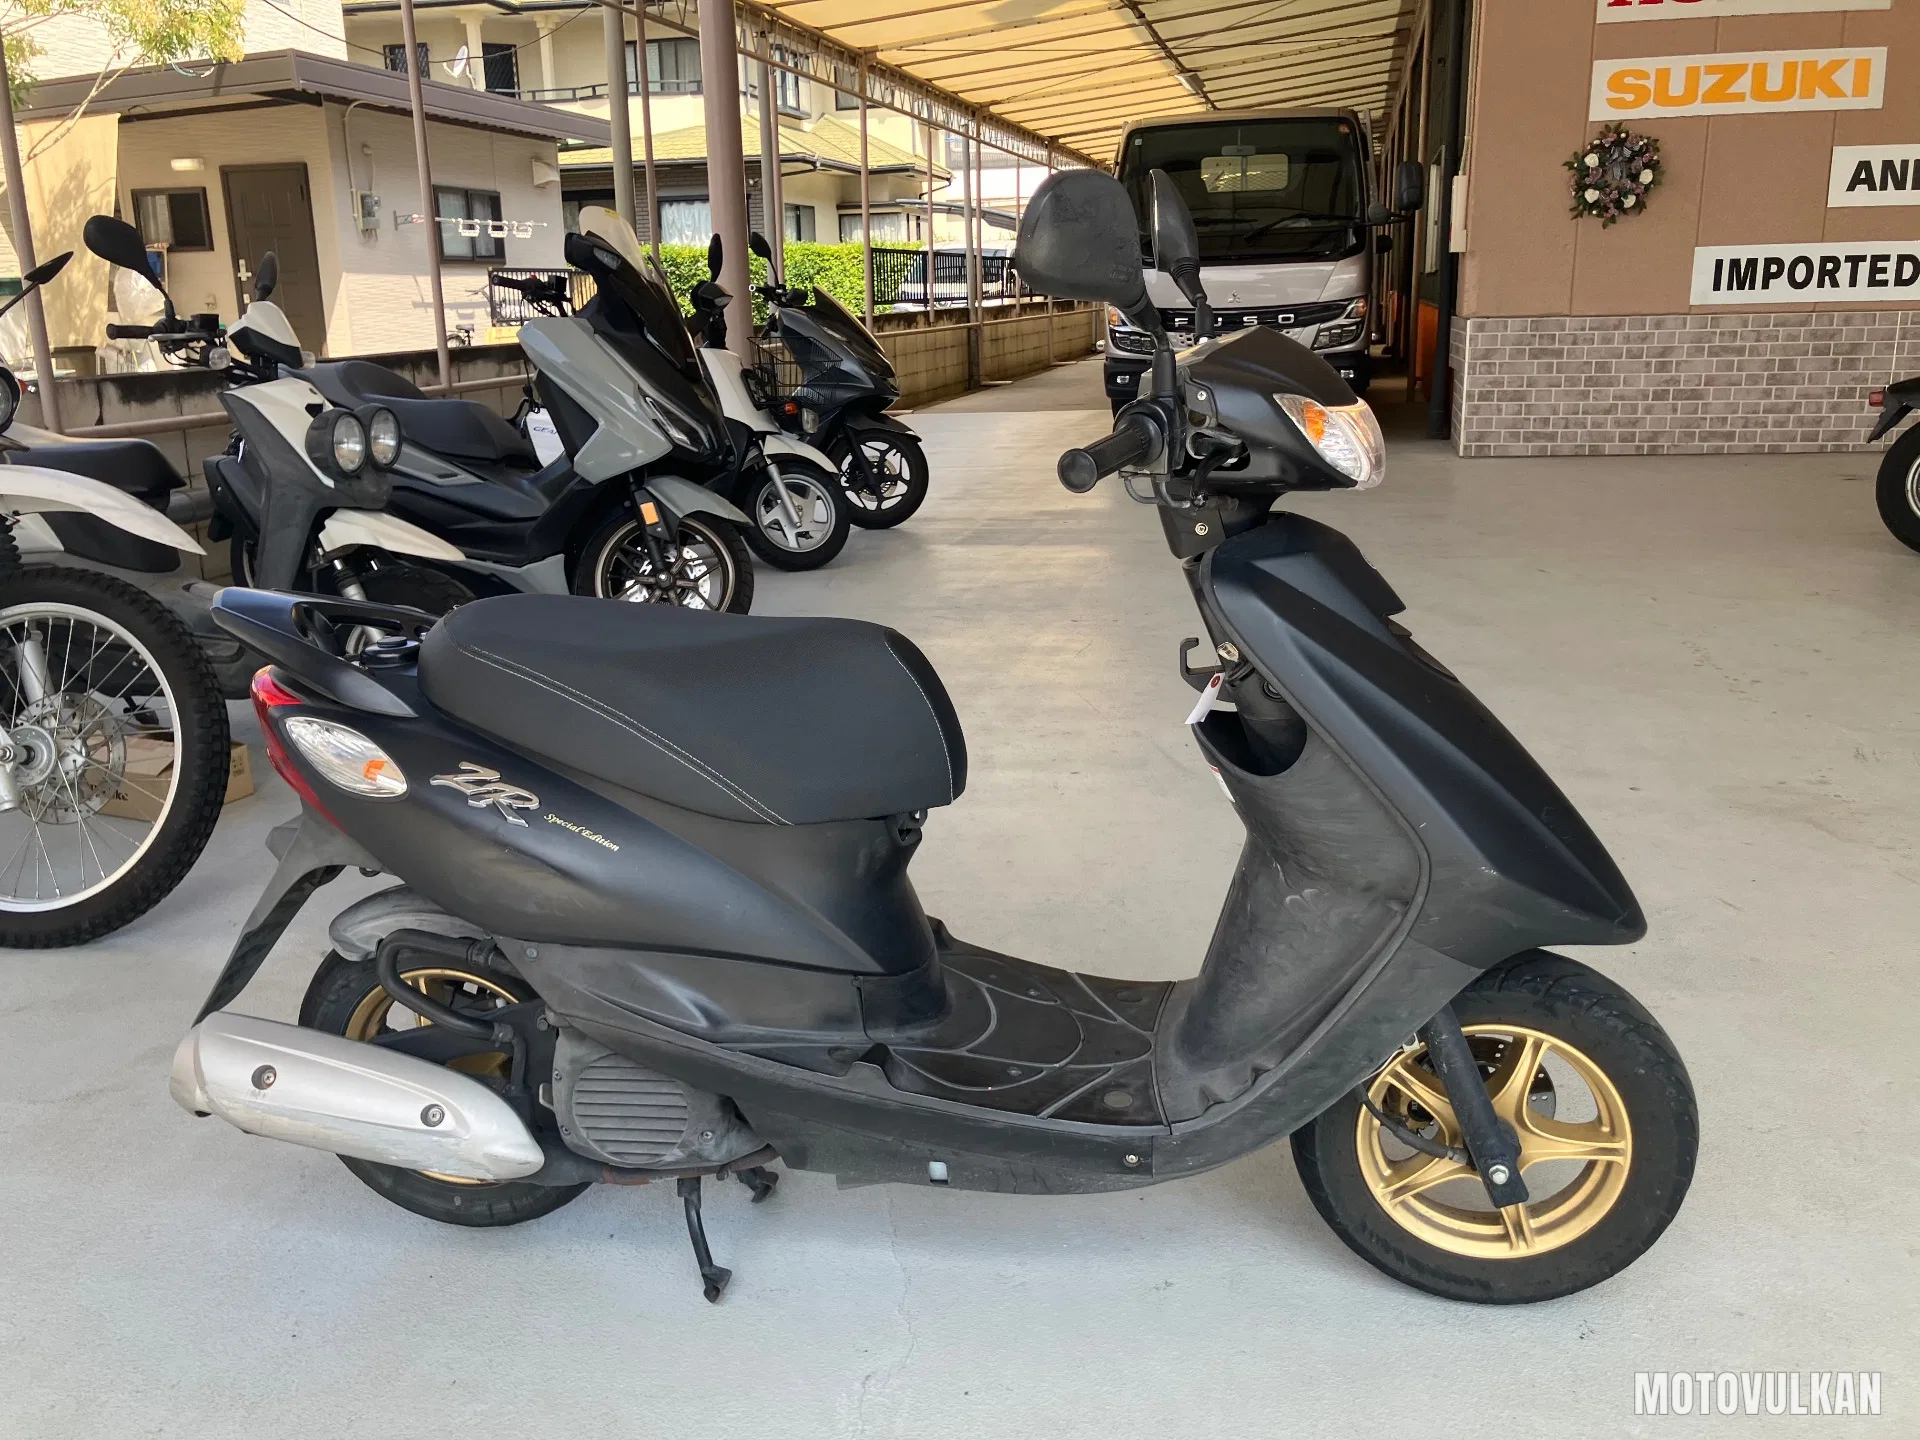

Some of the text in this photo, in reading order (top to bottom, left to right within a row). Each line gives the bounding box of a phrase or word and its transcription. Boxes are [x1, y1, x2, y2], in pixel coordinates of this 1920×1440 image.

[1605, 58, 1872, 110] SUZUKI
[1712, 253, 1920, 291] IMPORTED
[543, 813, 620, 852] Special Edition
